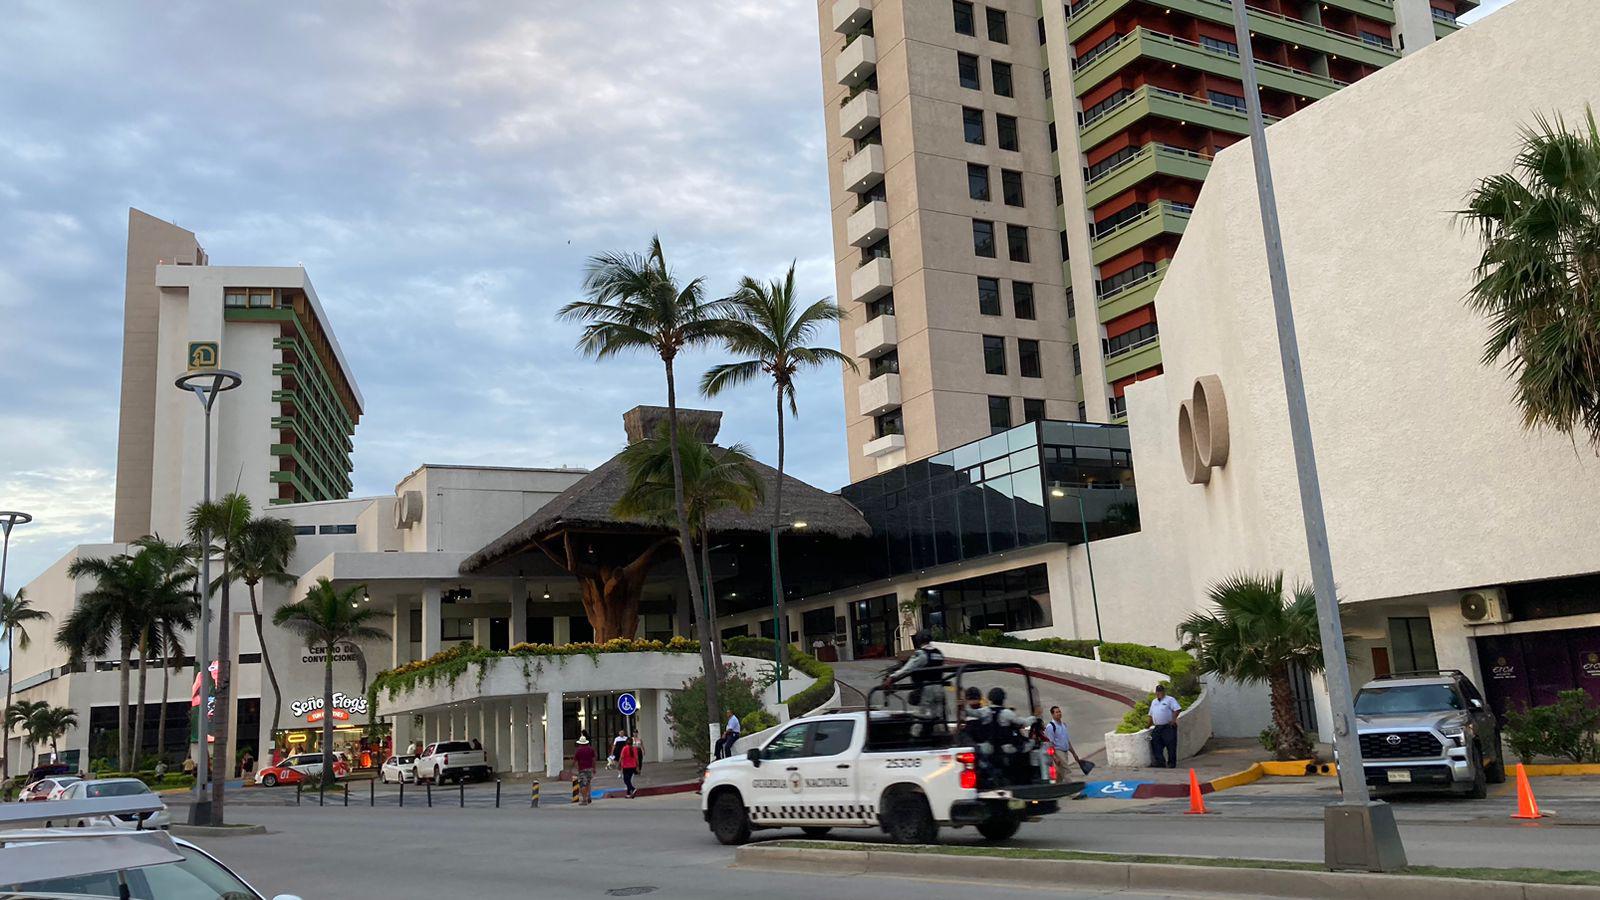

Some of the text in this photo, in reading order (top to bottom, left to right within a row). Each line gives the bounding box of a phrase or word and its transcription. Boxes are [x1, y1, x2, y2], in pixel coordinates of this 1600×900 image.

[302, 654, 360, 663] CONVECIONE
[291, 693, 368, 717] Seño Frog's
[752, 777, 849, 789] GUARDIA NACIONAL
